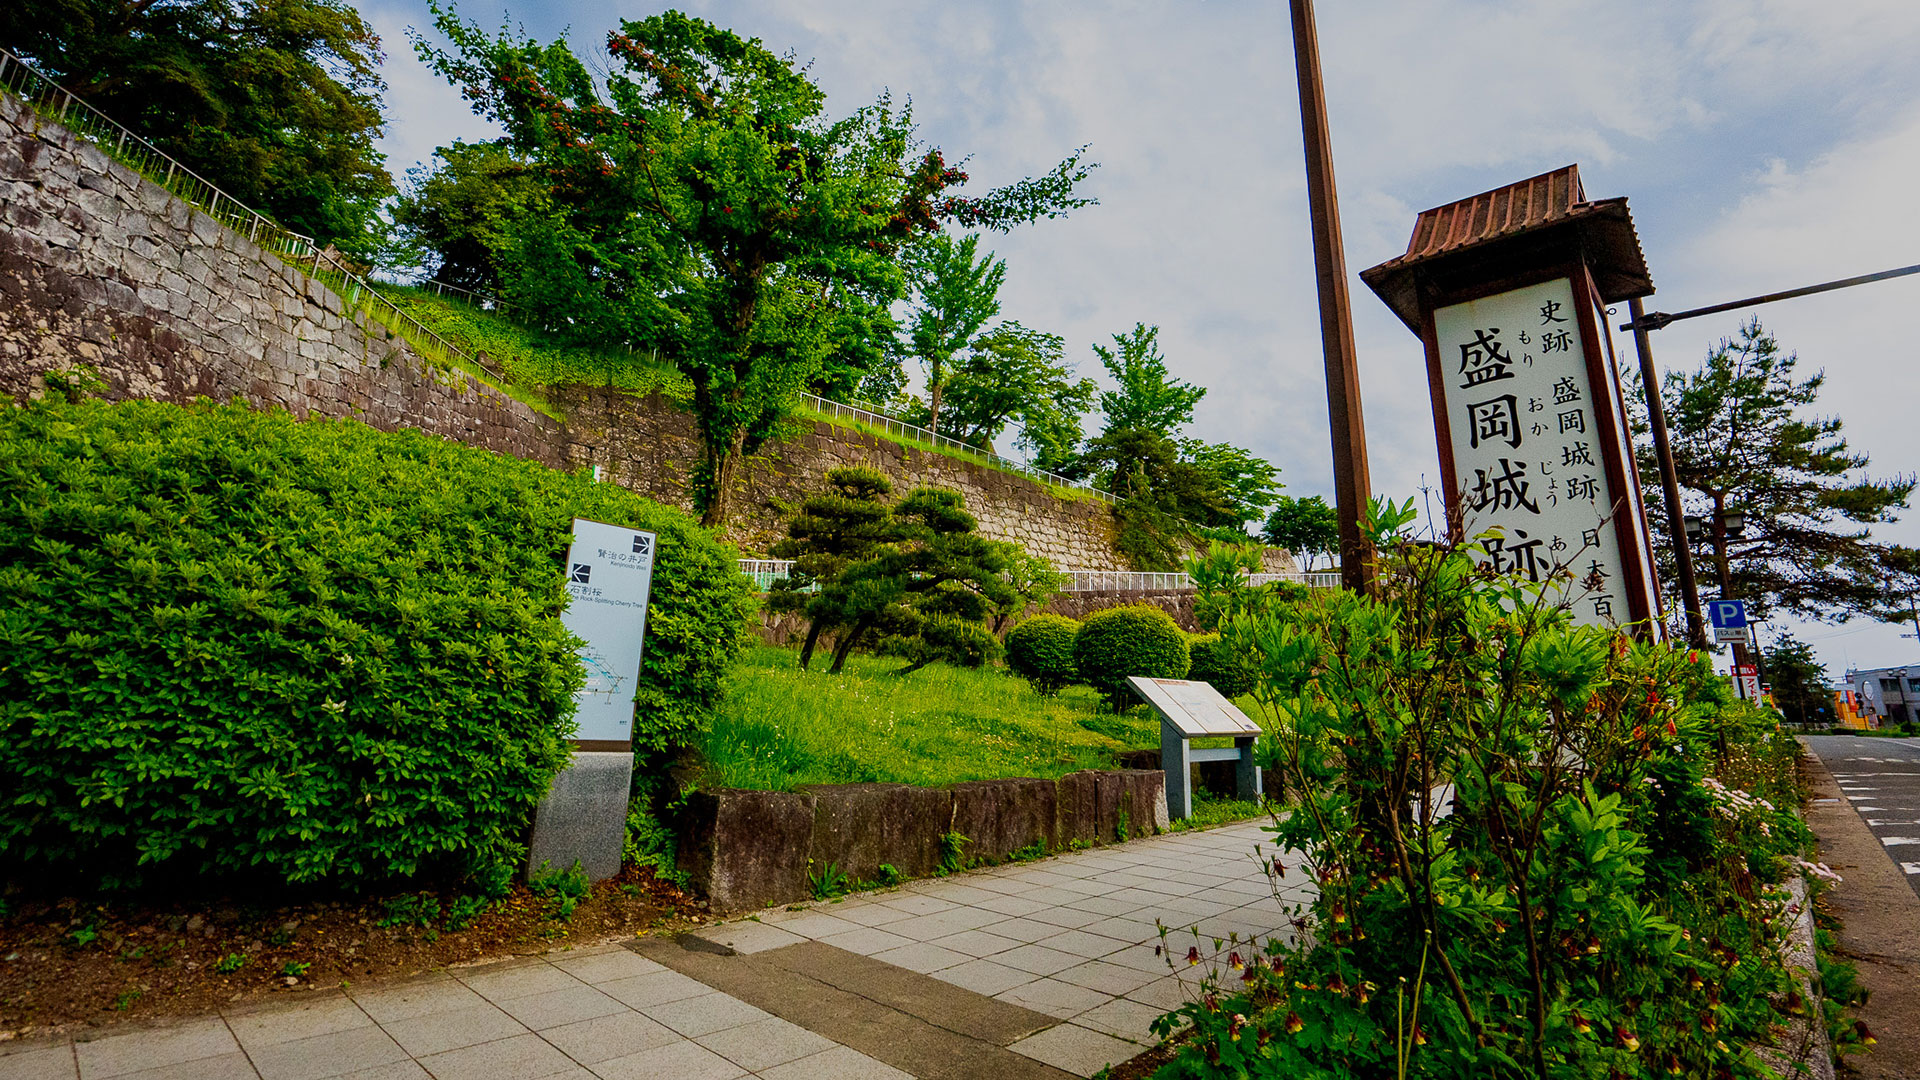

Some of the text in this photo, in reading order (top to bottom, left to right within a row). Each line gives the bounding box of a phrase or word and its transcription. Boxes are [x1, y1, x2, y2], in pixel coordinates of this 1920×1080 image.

[1540, 300, 1573, 354] 史跡
[1552, 376, 1600, 501] 盛岡城跡
[1458, 328, 1550, 583] 盛岡城跡
[598, 549, 647, 564] 賢治の井戸
[570, 585, 602, 596] 石割桜
[615, 600, 632, 608] Cherry
[1718, 603, 1738, 625] P
